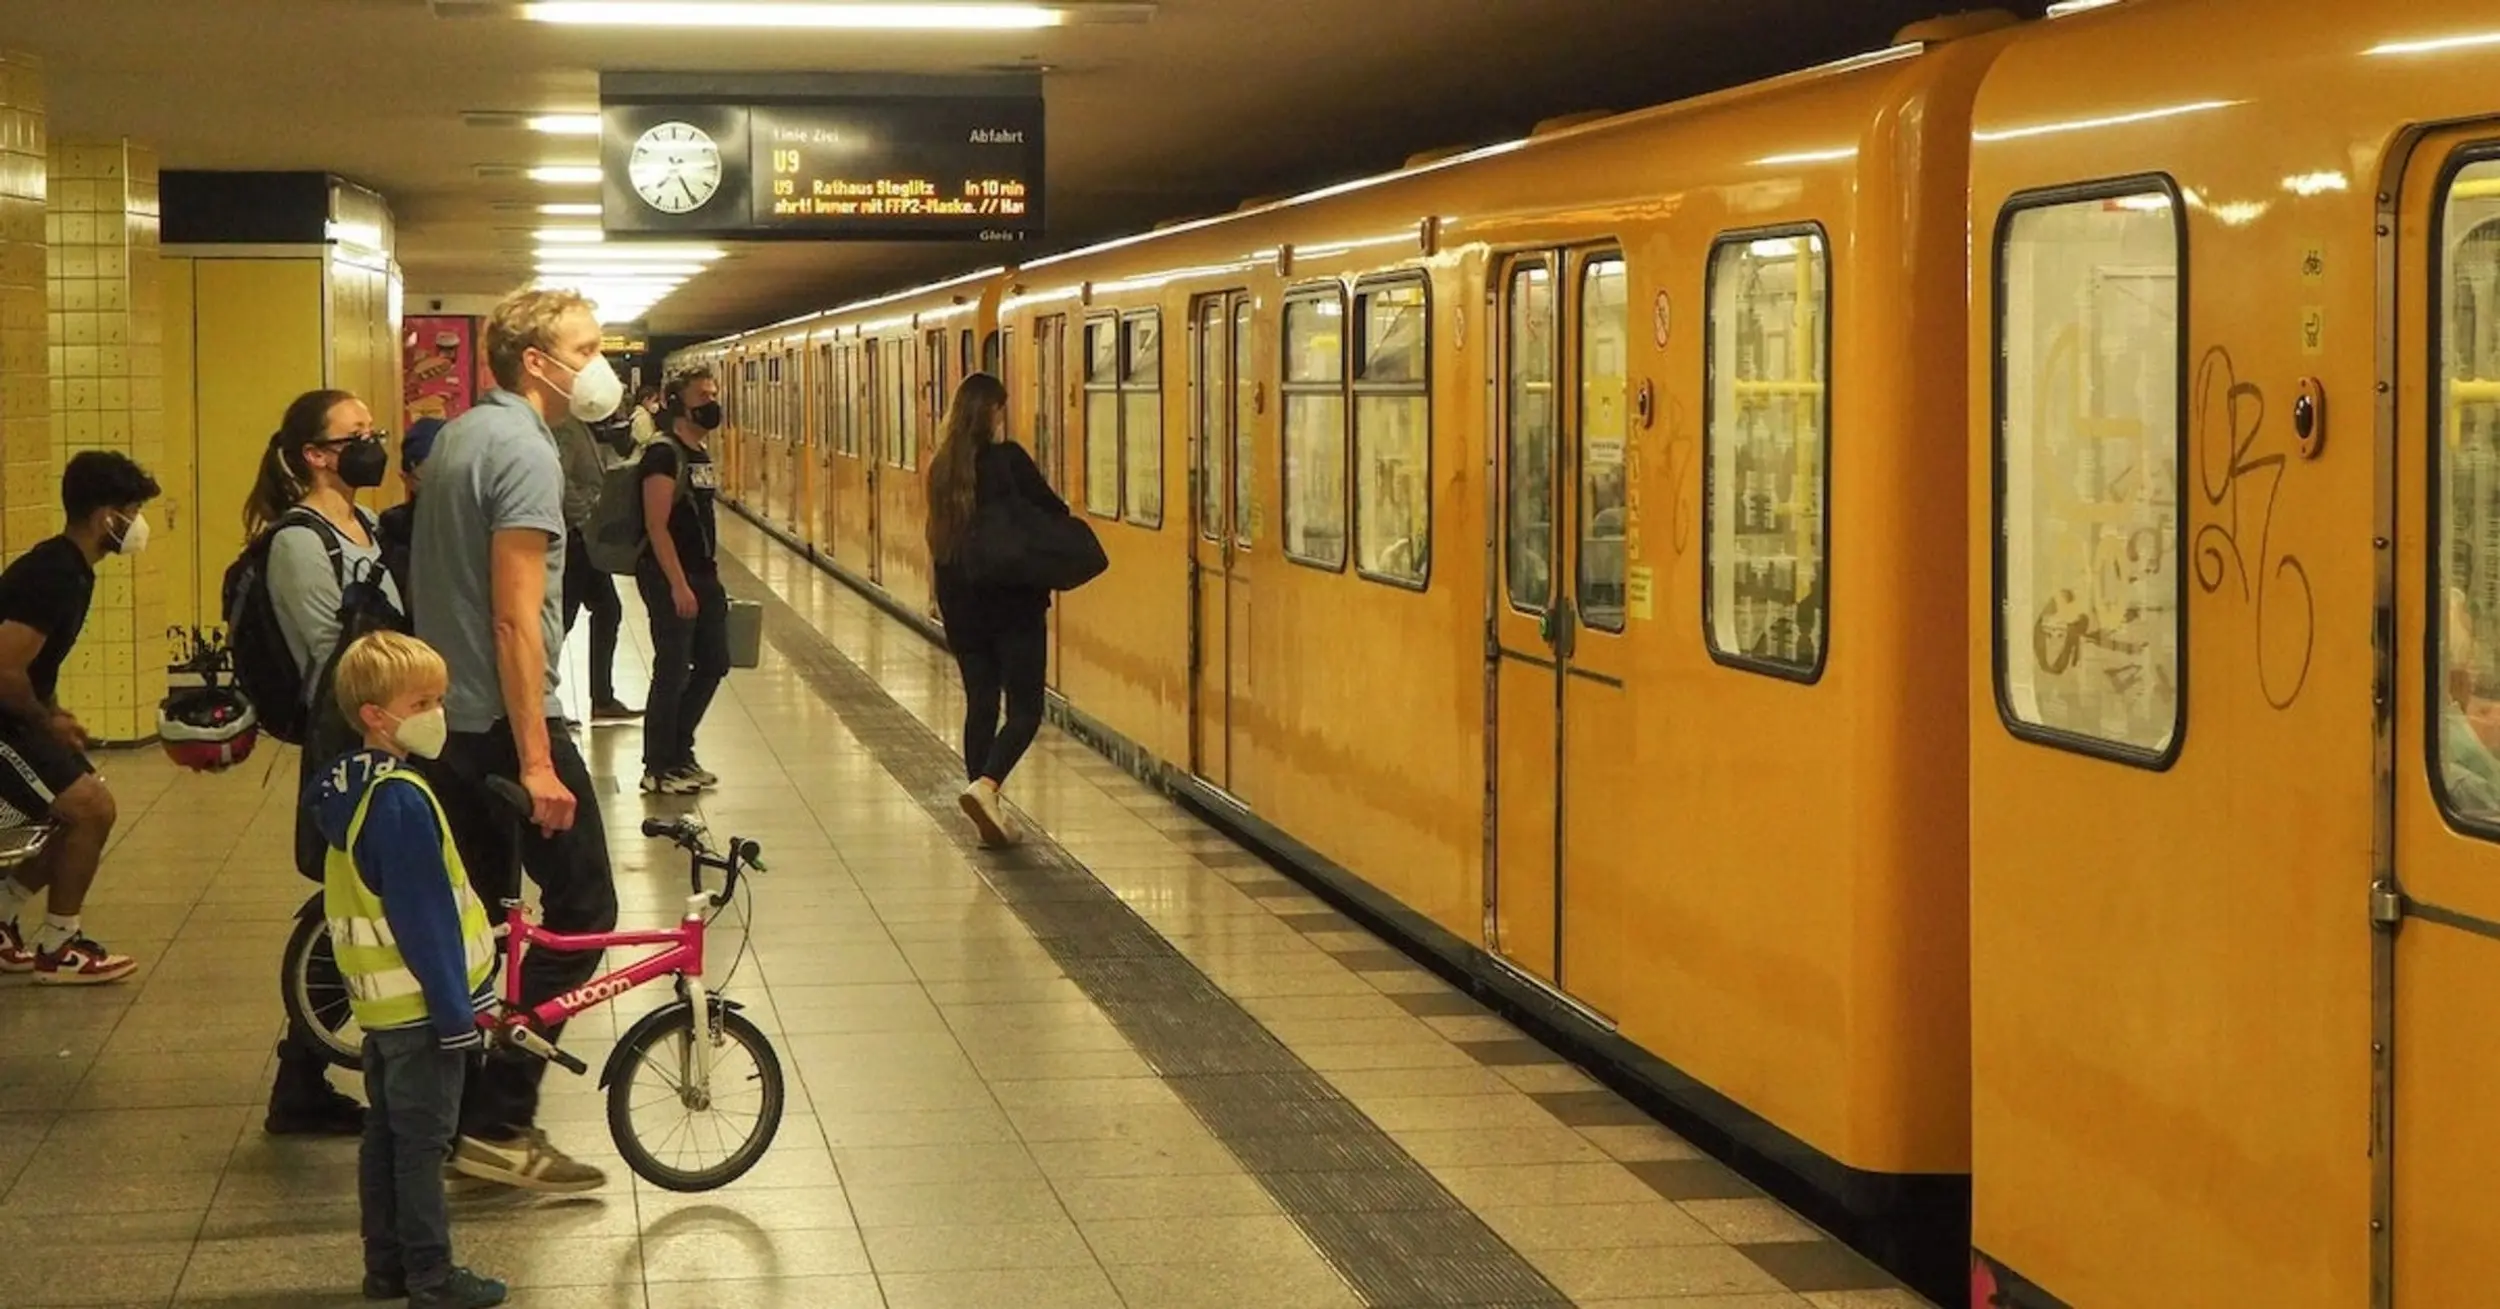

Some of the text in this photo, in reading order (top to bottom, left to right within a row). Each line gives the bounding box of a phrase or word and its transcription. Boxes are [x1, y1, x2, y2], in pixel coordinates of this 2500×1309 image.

[969, 129, 1024, 143] Abfahrt
[773, 149, 800, 174] U9
[773, 179, 1025, 198] U9 Rathaus Steglitz in 10 min
[815, 198, 859, 214] Immer
[860, 198, 883, 214] mit
[885, 198, 977, 214] FFP2-Maske.
[979, 230, 1025, 241] Gleis 1
[553, 976, 632, 1009] woom
